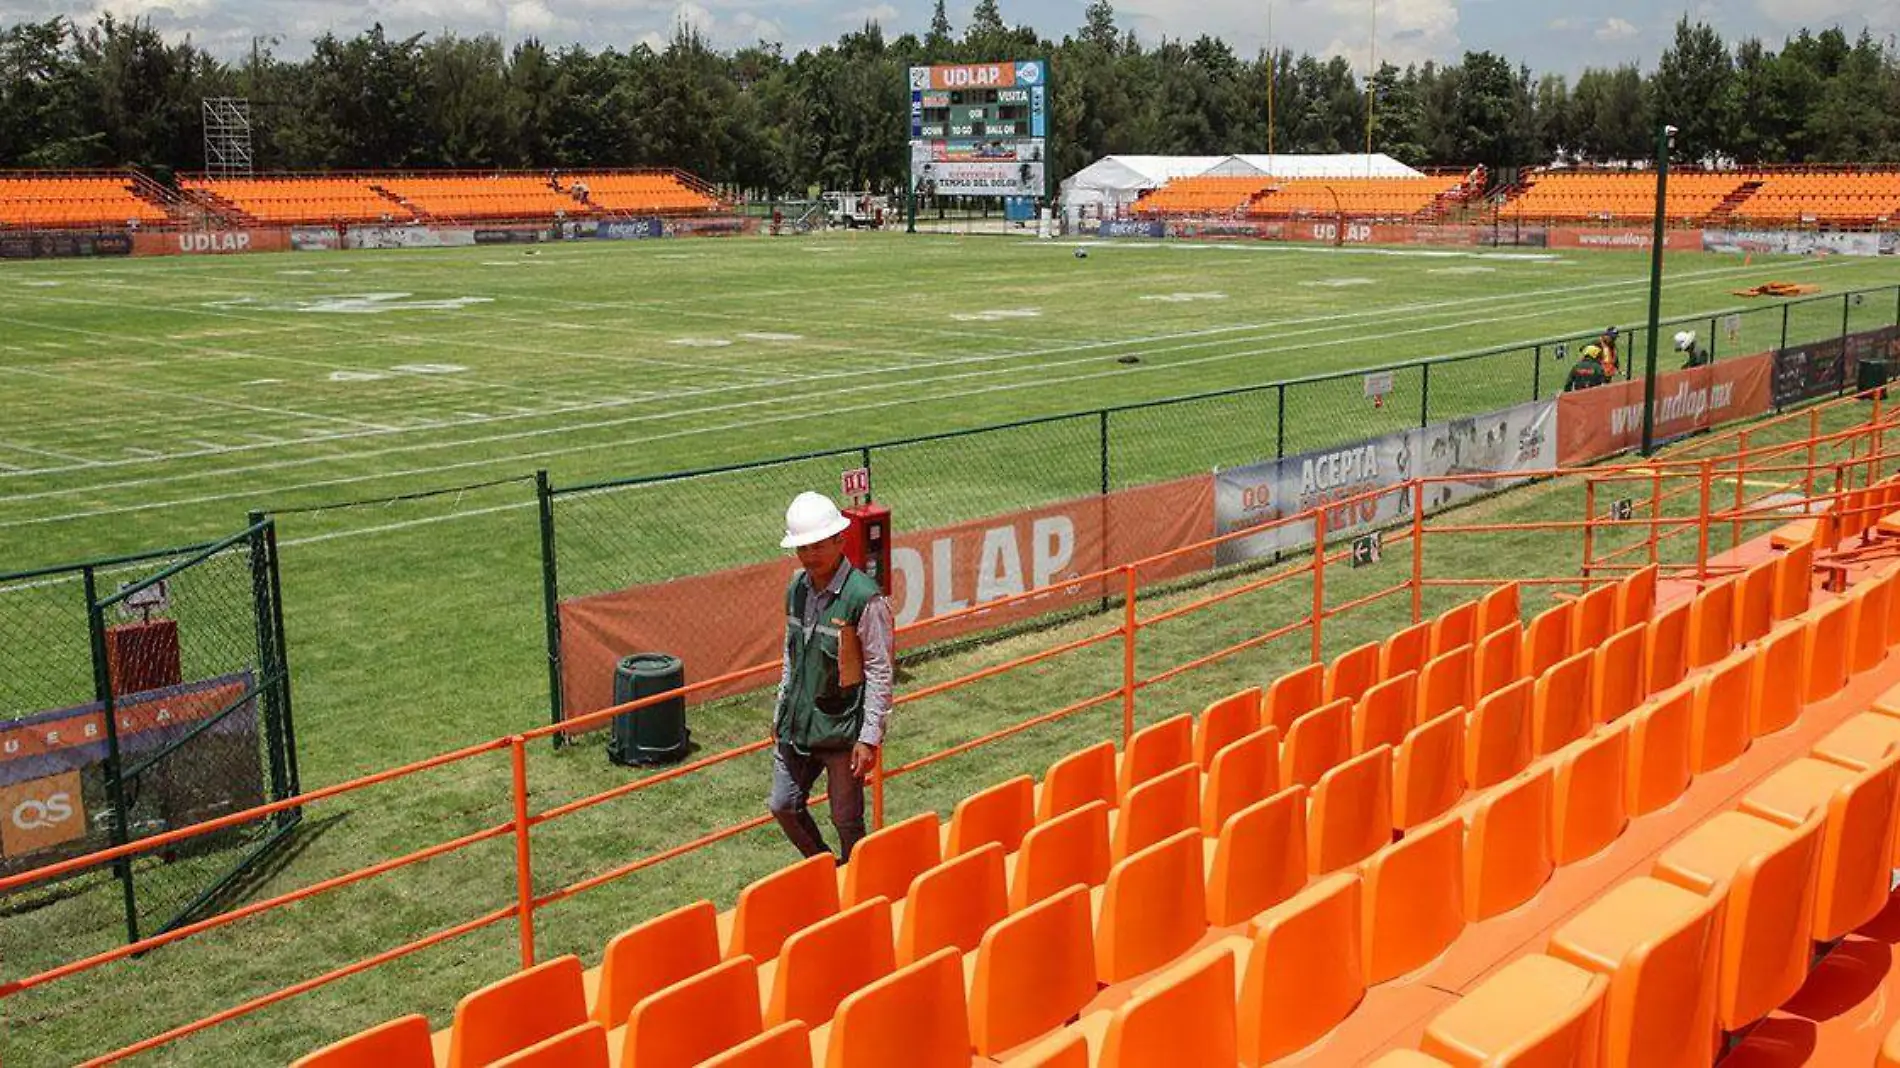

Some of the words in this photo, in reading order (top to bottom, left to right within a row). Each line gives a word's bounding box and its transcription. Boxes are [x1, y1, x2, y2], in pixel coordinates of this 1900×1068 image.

[943, 67, 1000, 86] UDLAP
[922, 126, 943, 136] DOWN
[939, 179, 971, 187] TEMPLO
[1314, 223, 1371, 241] UDAP
[1579, 231, 1670, 247] www.udlap.x
[179, 233, 251, 252] UDLAP
[1611, 380, 1734, 435] ww.udlap.mx
[1301, 445, 1378, 495] ACEPTA
[12, 791, 73, 830] QS
